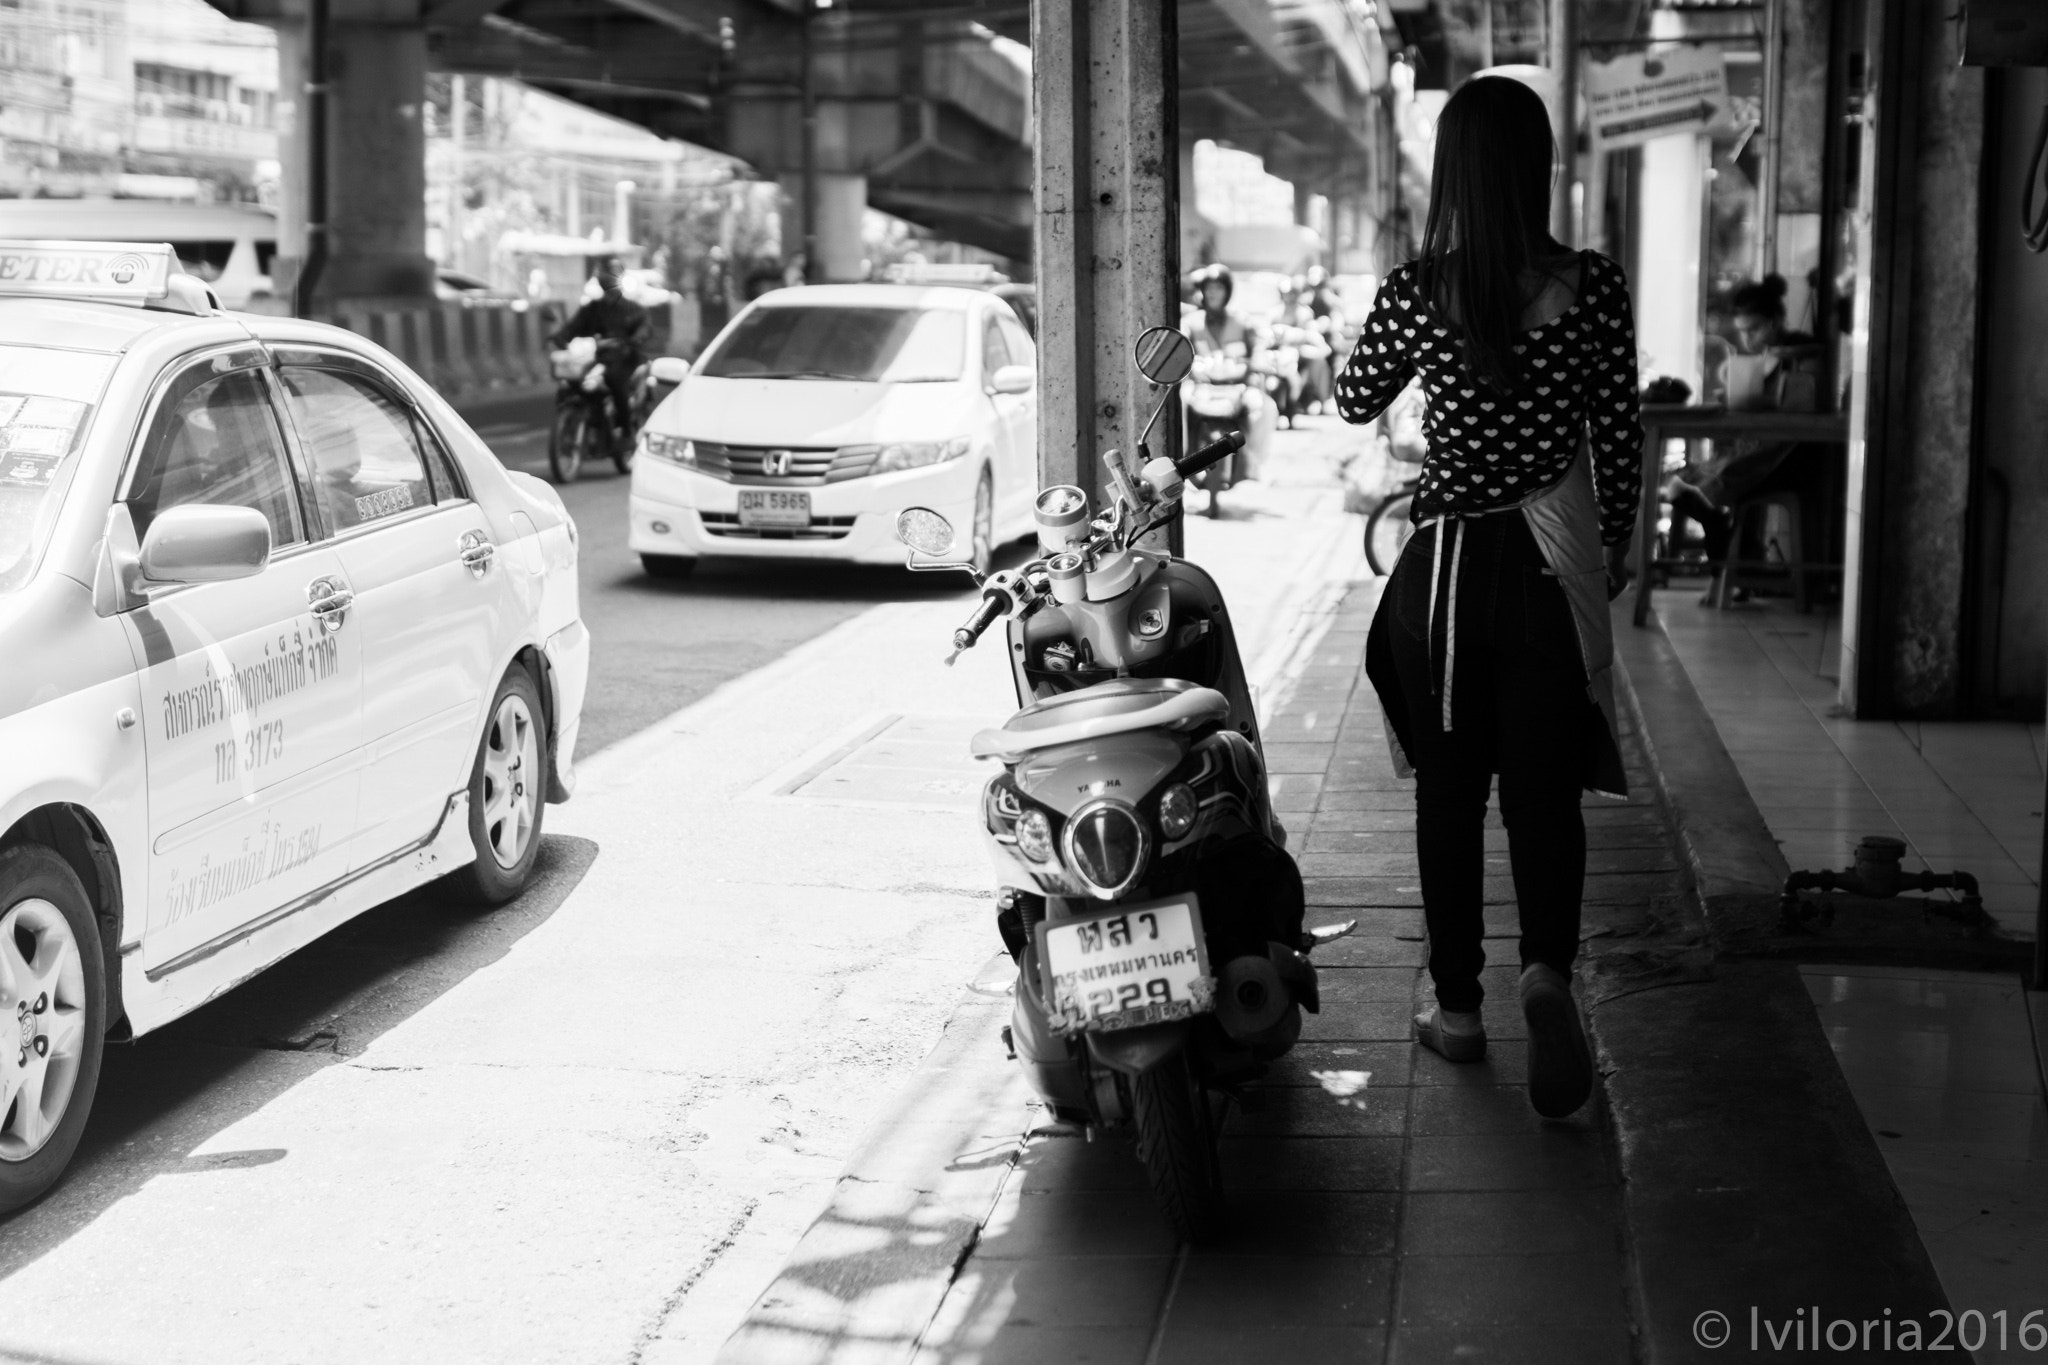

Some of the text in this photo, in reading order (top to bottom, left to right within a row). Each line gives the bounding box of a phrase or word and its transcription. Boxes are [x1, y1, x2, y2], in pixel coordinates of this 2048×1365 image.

[769, 492, 807, 509] 5965
[244, 718, 284, 772] 3173
[1077, 779, 1121, 793] YAHA
[1088, 977, 1172, 1020] 229
